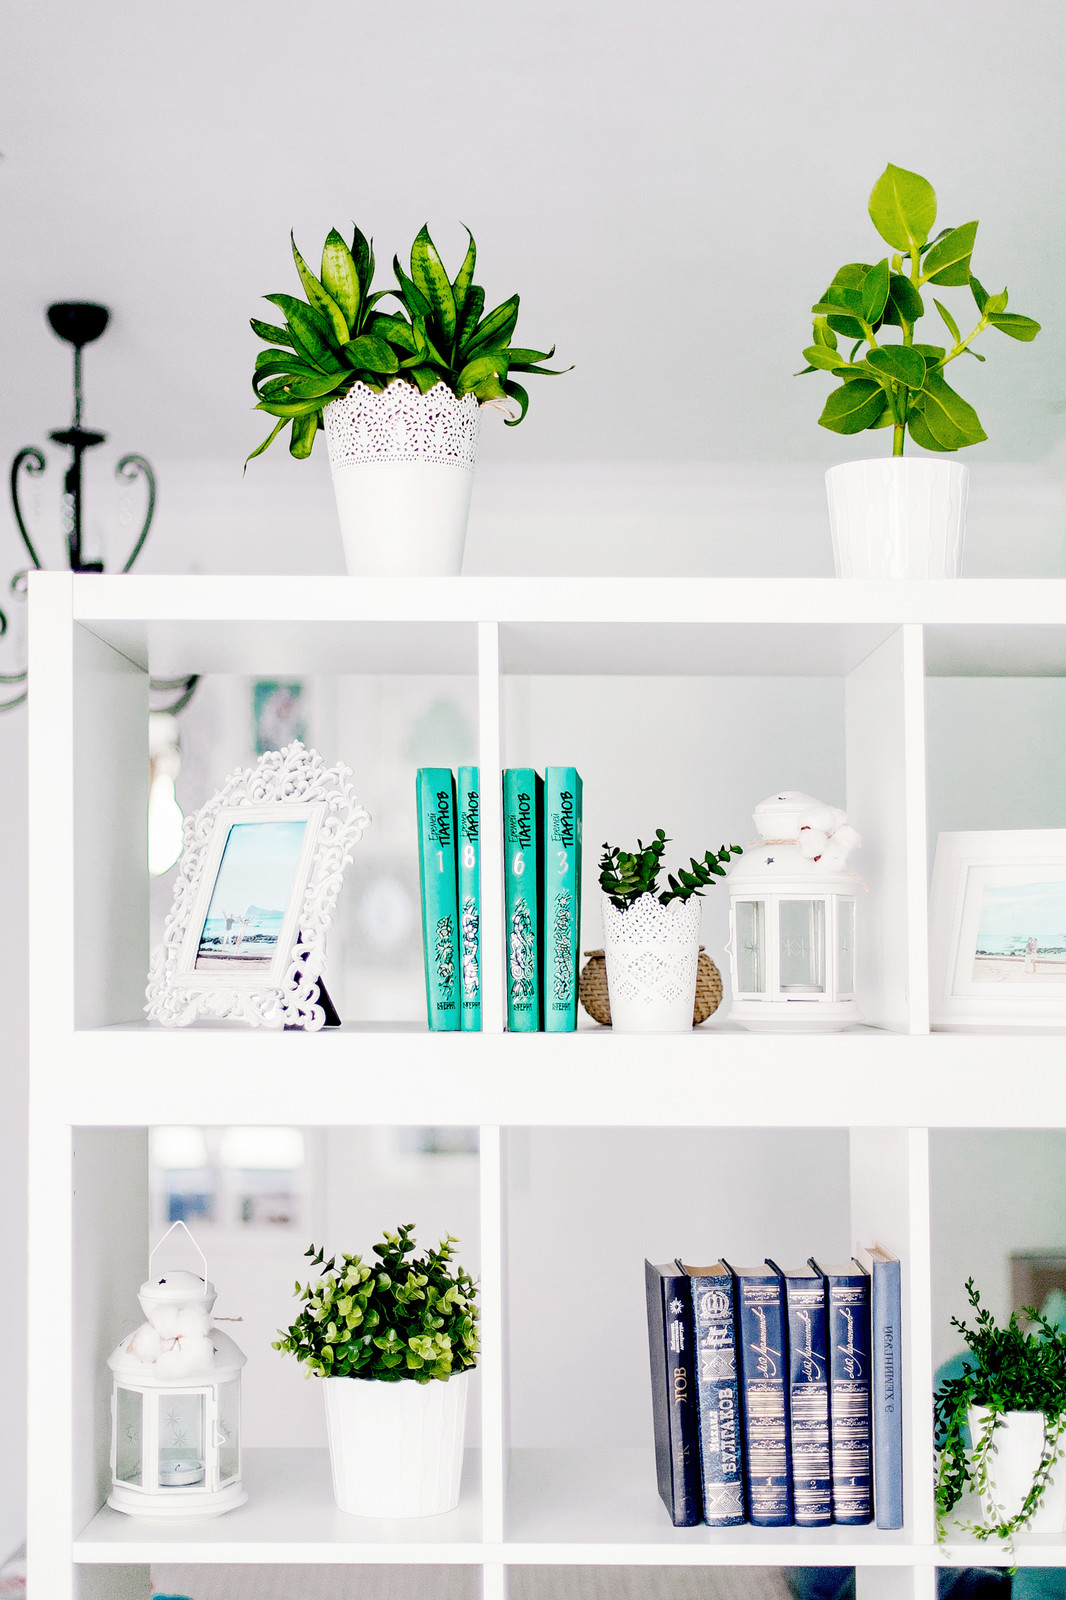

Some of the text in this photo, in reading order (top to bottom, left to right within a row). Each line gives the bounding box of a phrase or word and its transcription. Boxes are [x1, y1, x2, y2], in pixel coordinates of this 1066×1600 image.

[436, 791, 451, 848] ПАРНОВ
[466, 791, 479, 844] ПАРНОВ
[517, 793, 532, 850] ПАРНОВ
[560, 791, 574, 849] ПАРНОВ
[436, 850, 444, 873] 1
[463, 845, 475, 869] 8
[513, 851, 525, 875] 6
[557, 850, 569, 875] 3
[883, 1325, 895, 1401] ХЕМИНГУЭЙ
[718, 1387, 737, 1474] БУЛГАКОВ
[766, 1476, 773, 1487] 1
[809, 1480, 817, 1490] 2
[849, 1477, 856, 1486] 1
